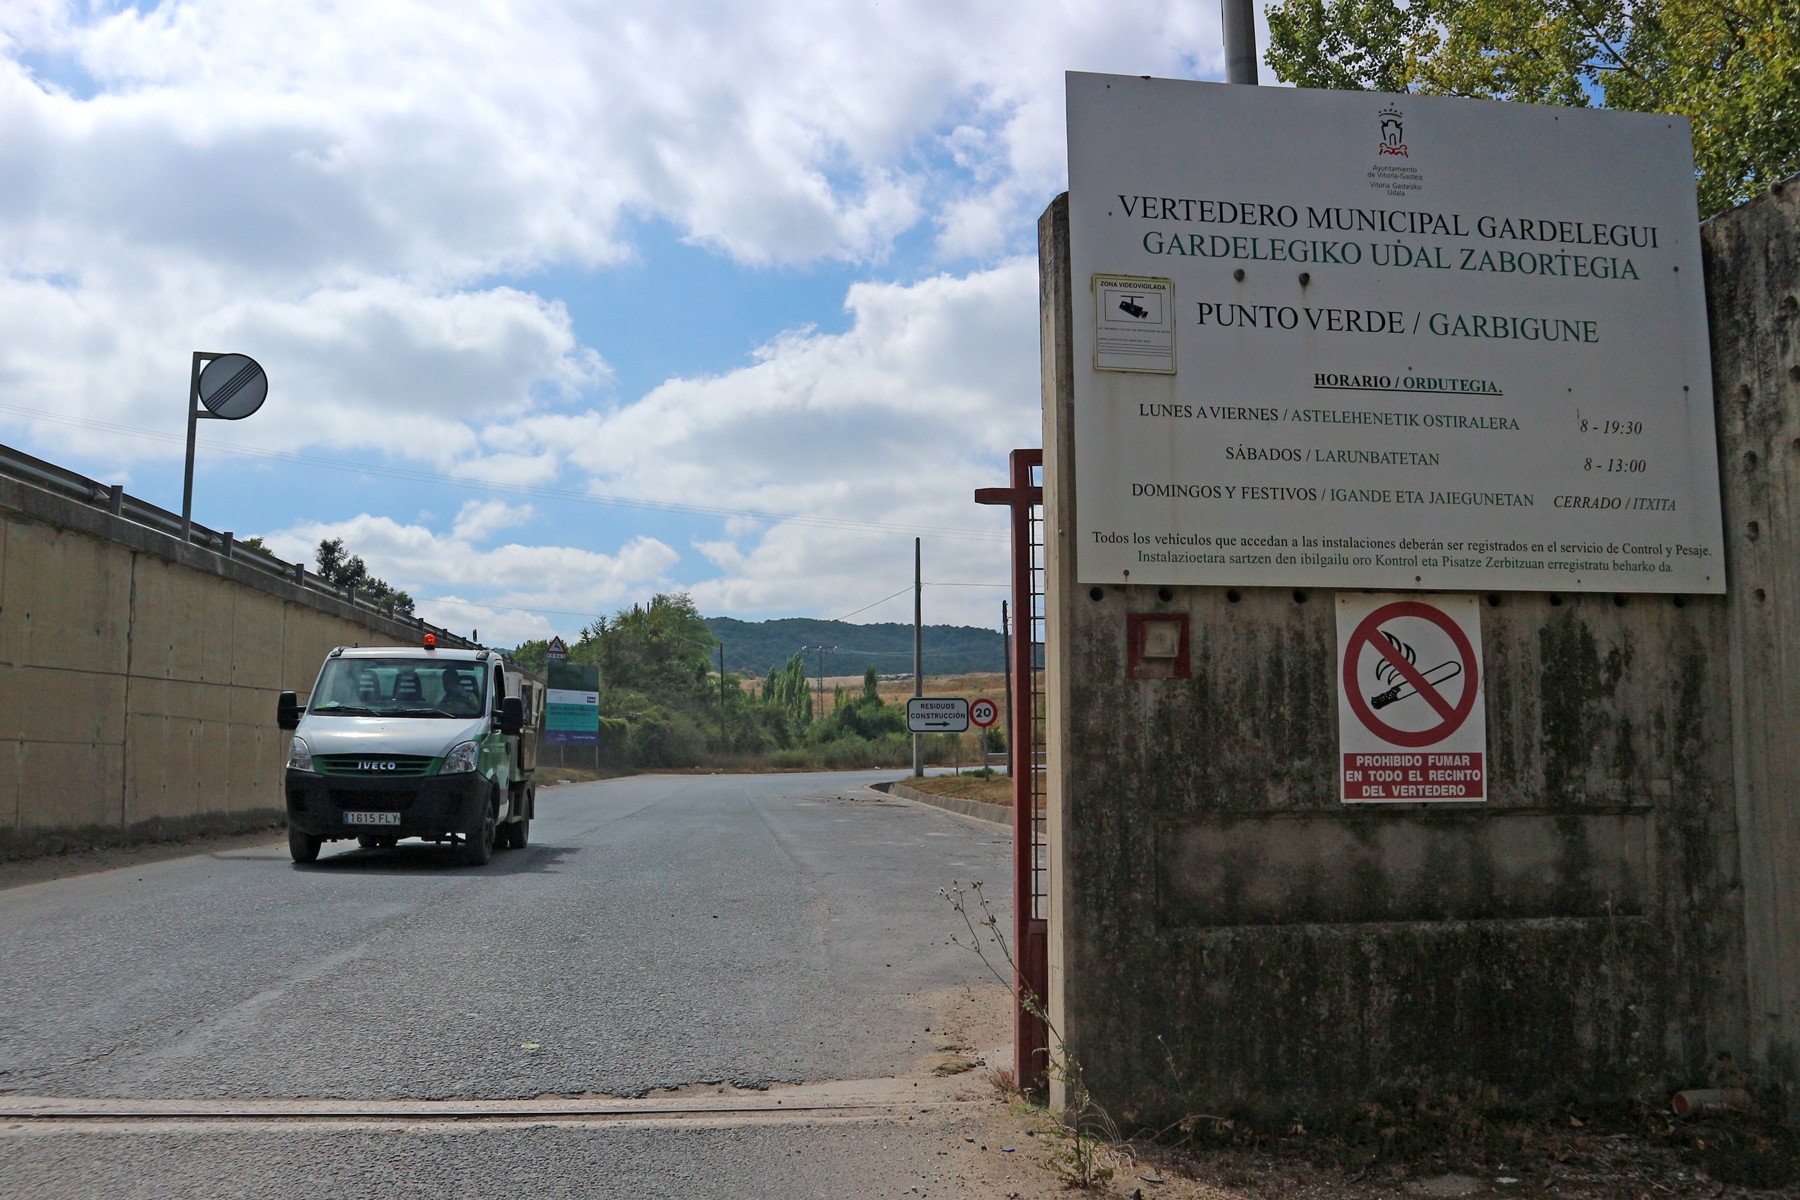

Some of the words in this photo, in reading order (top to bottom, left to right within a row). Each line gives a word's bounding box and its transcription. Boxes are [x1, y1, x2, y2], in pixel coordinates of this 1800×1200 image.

[1372, 165, 1417, 173] Ayuntamiento
[1119, 194, 1298, 227] VERTEDERO
[1307, 207, 1469, 236] MUNICIPAL
[1477, 216, 1659, 248] GARDELEGUI
[1143, 231, 1361, 264] GARDELEGIKO
[1371, 243, 1451, 269] UDAL
[1460, 248, 1640, 280] ZABORTEGIA
[1119, 282, 1166, 290] VIDEOVIGILADA
[1197, 302, 1298, 329] PUNTO
[1303, 307, 1405, 334] VERDE
[1429, 313, 1599, 343] GARBIGUNE
[1314, 373, 1391, 388] HORARIO
[1403, 376, 1503, 393] ORDUTEGIA.
[1140, 404, 1192, 418] LUNES
[1196, 406, 1208, 419] A
[1210, 406, 1278, 421] VIERNES
[1291, 409, 1419, 427] ASTELEHENETIK
[1423, 414, 1520, 431] OSTIRALERA
[1580, 419, 1588, 433] 8
[1603, 420, 1642, 435] 19:30
[1226, 444, 1302, 462] SÁBADOS
[1315, 450, 1439, 466] LARUNBATETAN
[1584, 458, 1592, 471] 8
[1608, 458, 1646, 473] 13:00
[1132, 484, 1221, 499] DOMINGOS
[1225, 487, 1236, 498] Y
[1241, 487, 1316, 501] FESTIVOS
[1331, 489, 1391, 503] IGANDE
[1396, 491, 1424, 504] ETA
[1429, 491, 1534, 507] JAIEGUNETAN
[1553, 495, 1621, 510] CERRADO
[1632, 498, 1676, 511] ITXITA
[1093, 531, 1129, 544] Todos
[1133, 532, 1150, 545] los
[1155, 533, 1212, 546] vehículos
[1215, 537, 1236, 549] que
[1240, 535, 1288, 547] accedan
[1291, 538, 1298, 547] a
[1302, 536, 1318, 548] las
[1322, 536, 1396, 549] instalaciones
[1399, 538, 1443, 550] deberán
[1447, 542, 1463, 551] ser
[1467, 540, 1528, 554] registrados
[1531, 543, 1544, 552] en
[1547, 541, 1557, 552] el
[1560, 542, 1603, 554] servicio
[1606, 543, 1619, 554] de
[1622, 543, 1662, 555] Control
[1665, 547, 1672, 557] y
[1676, 544, 1712, 559] Pesaje.
[1138, 550, 1226, 563] Instalazioetara
[1229, 553, 1271, 564] sartzen
[1275, 552, 1297, 564] den
[1301, 553, 1349, 567] ibilgailu
[1352, 556, 1372, 566] oro
[1375, 554, 1418, 567] Kontrol
[1421, 557, 1438, 567] eta
[1442, 556, 1482, 568] Pisatze
[1485, 556, 1544, 569] Zerbitzuan
[1547, 558, 1609, 573] erregistratu
[1612, 559, 1656, 572] beharko
[975, 708, 992, 718] 20
[358, 761, 396, 770] IVECO
[1356, 755, 1423, 767] PROHIBIDO
[1428, 755, 1470, 767] FUMAR
[1345, 770, 1363, 782] EN
[1368, 770, 1403, 782] TODO
[1408, 770, 1423, 781] EL
[1429, 769, 1481, 781] RECINTO
[1362, 785, 1386, 797] DEL
[1392, 784, 1466, 797] VERTEDERO
[351, 813, 376, 823] 1615
[379, 814, 398, 824] FLY
